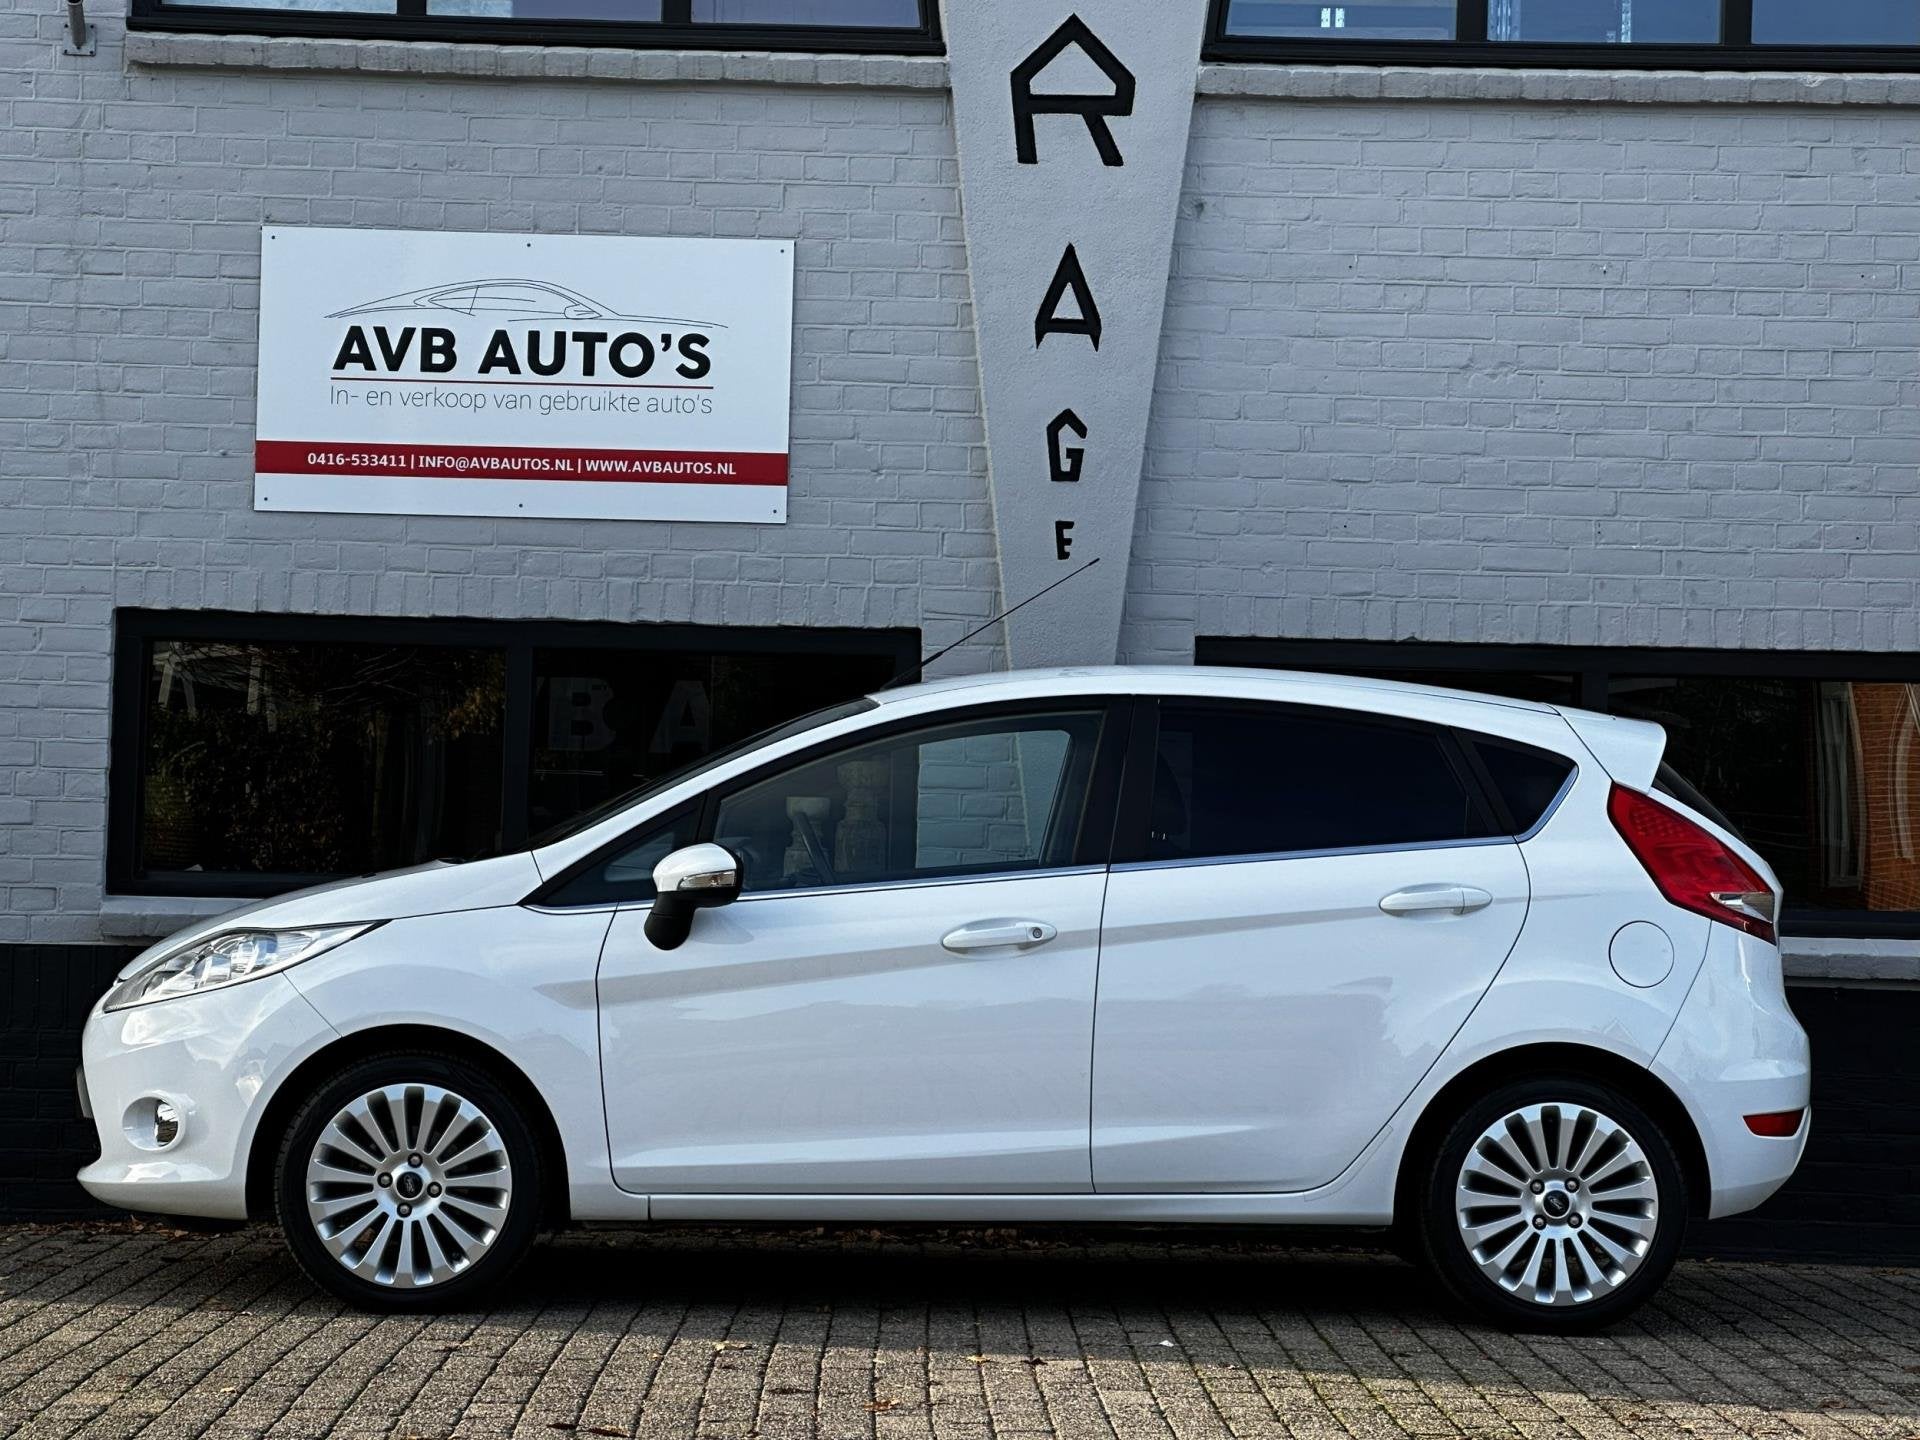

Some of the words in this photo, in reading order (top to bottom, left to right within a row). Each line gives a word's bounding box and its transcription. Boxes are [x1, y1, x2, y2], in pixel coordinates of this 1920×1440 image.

[332, 325, 458, 373] AVB
[477, 329, 712, 380] AUTO'S
[330, 385, 360, 406] In-
[366, 390, 392, 407] en
[399, 386, 487, 414] verkoop
[493, 393, 532, 410] van
[539, 389, 641, 416] gebruikte
[646, 394, 713, 415] auto's
[307, 452, 407, 468] 0416-533411
[418, 454, 575, 472] INFO@AVBAUTOS.NL
[585, 459, 737, 476] WWW.AVBAUTOS.NL
